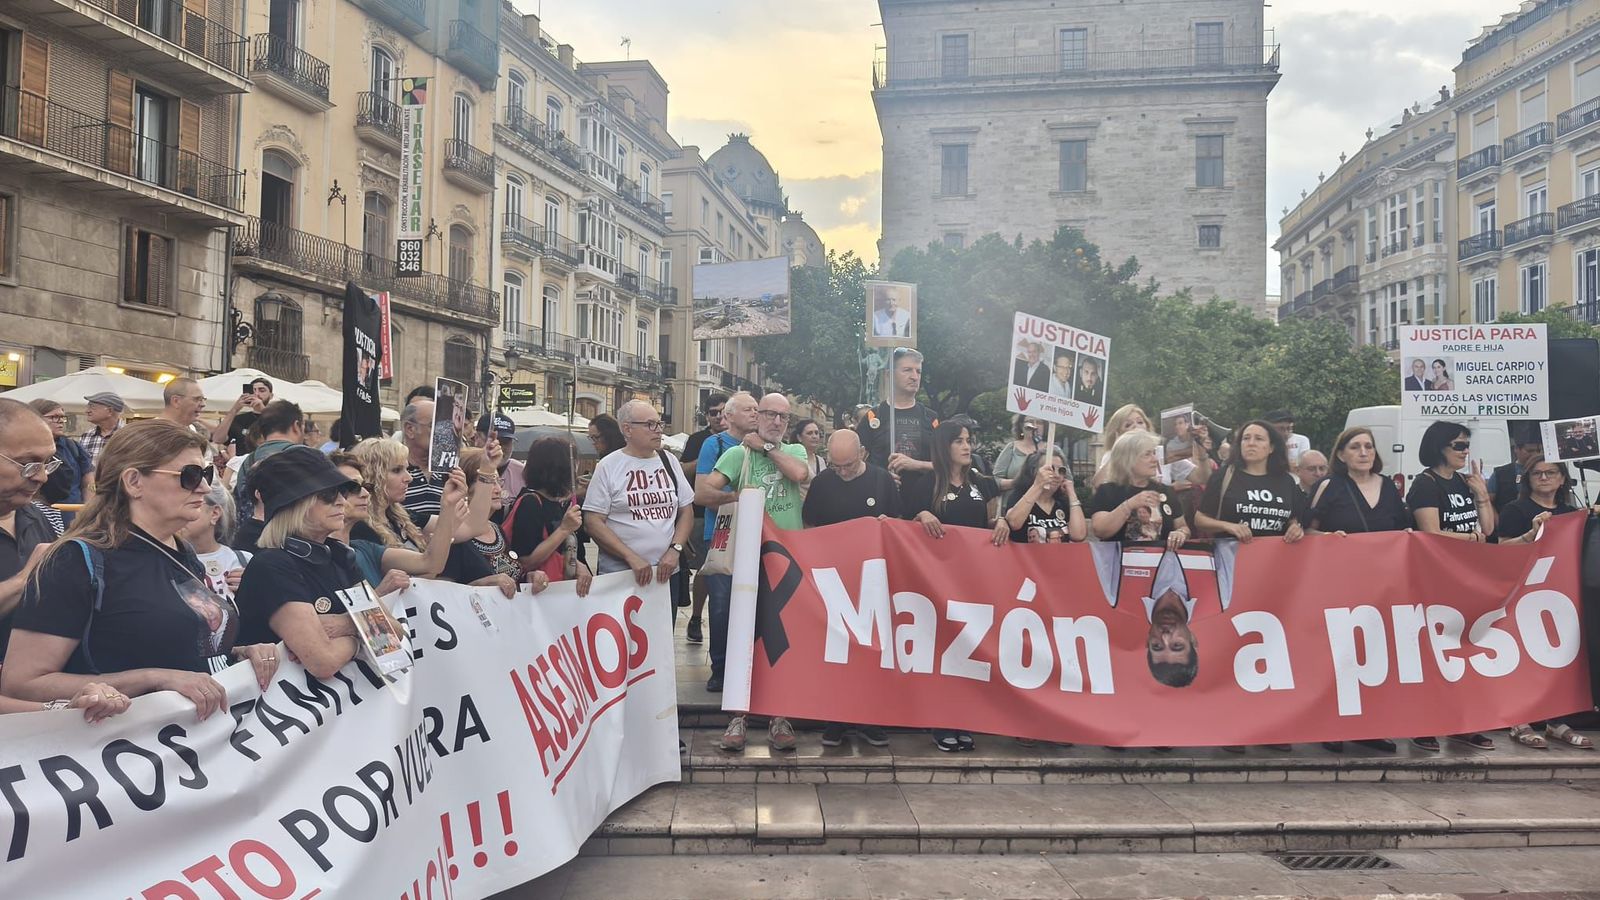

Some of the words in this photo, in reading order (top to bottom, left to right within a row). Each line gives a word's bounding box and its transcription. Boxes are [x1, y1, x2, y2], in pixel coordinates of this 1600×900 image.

[411, 108, 423, 232] TRASEJAR
[400, 241, 420, 251] 960
[400, 251, 420, 261] 032
[399, 261, 419, 271] 346
[381, 295, 390, 374] JUSTICIA
[1019, 318, 1106, 357] JUSTICIA
[1490, 328, 1537, 340] PARA
[1442, 344, 1473, 352] PADRE
[1483, 344, 1504, 352] HIJA
[1455, 362, 1494, 371] MIGUEL
[1496, 361, 1535, 371] CARPIO
[1538, 361, 1544, 371] Y
[1465, 375, 1494, 384] SARA
[1496, 375, 1535, 384] CARPIO
[1035, 392, 1046, 400] por
[1413, 394, 1420, 402] Y
[1423, 394, 1459, 402] TODAS
[1462, 393, 1484, 402] LAS
[1486, 393, 1538, 402] VICTIMAS
[1045, 405, 1057, 413] mis
[1058, 407, 1074, 417] hijos
[1421, 403, 1467, 415] MAZÓN
[1478, 403, 1529, 415] PRISIÓN
[627, 493, 640, 506] NI
[643, 490, 674, 505] OBLIT
[1247, 489, 1273, 502] NO
[1447, 493, 1465, 508] NO
[811, 558, 1115, 694] Mazón
[1231, 610, 1295, 692] a
[1324, 555, 1582, 716] presó
[278, 760, 399, 873] POR
